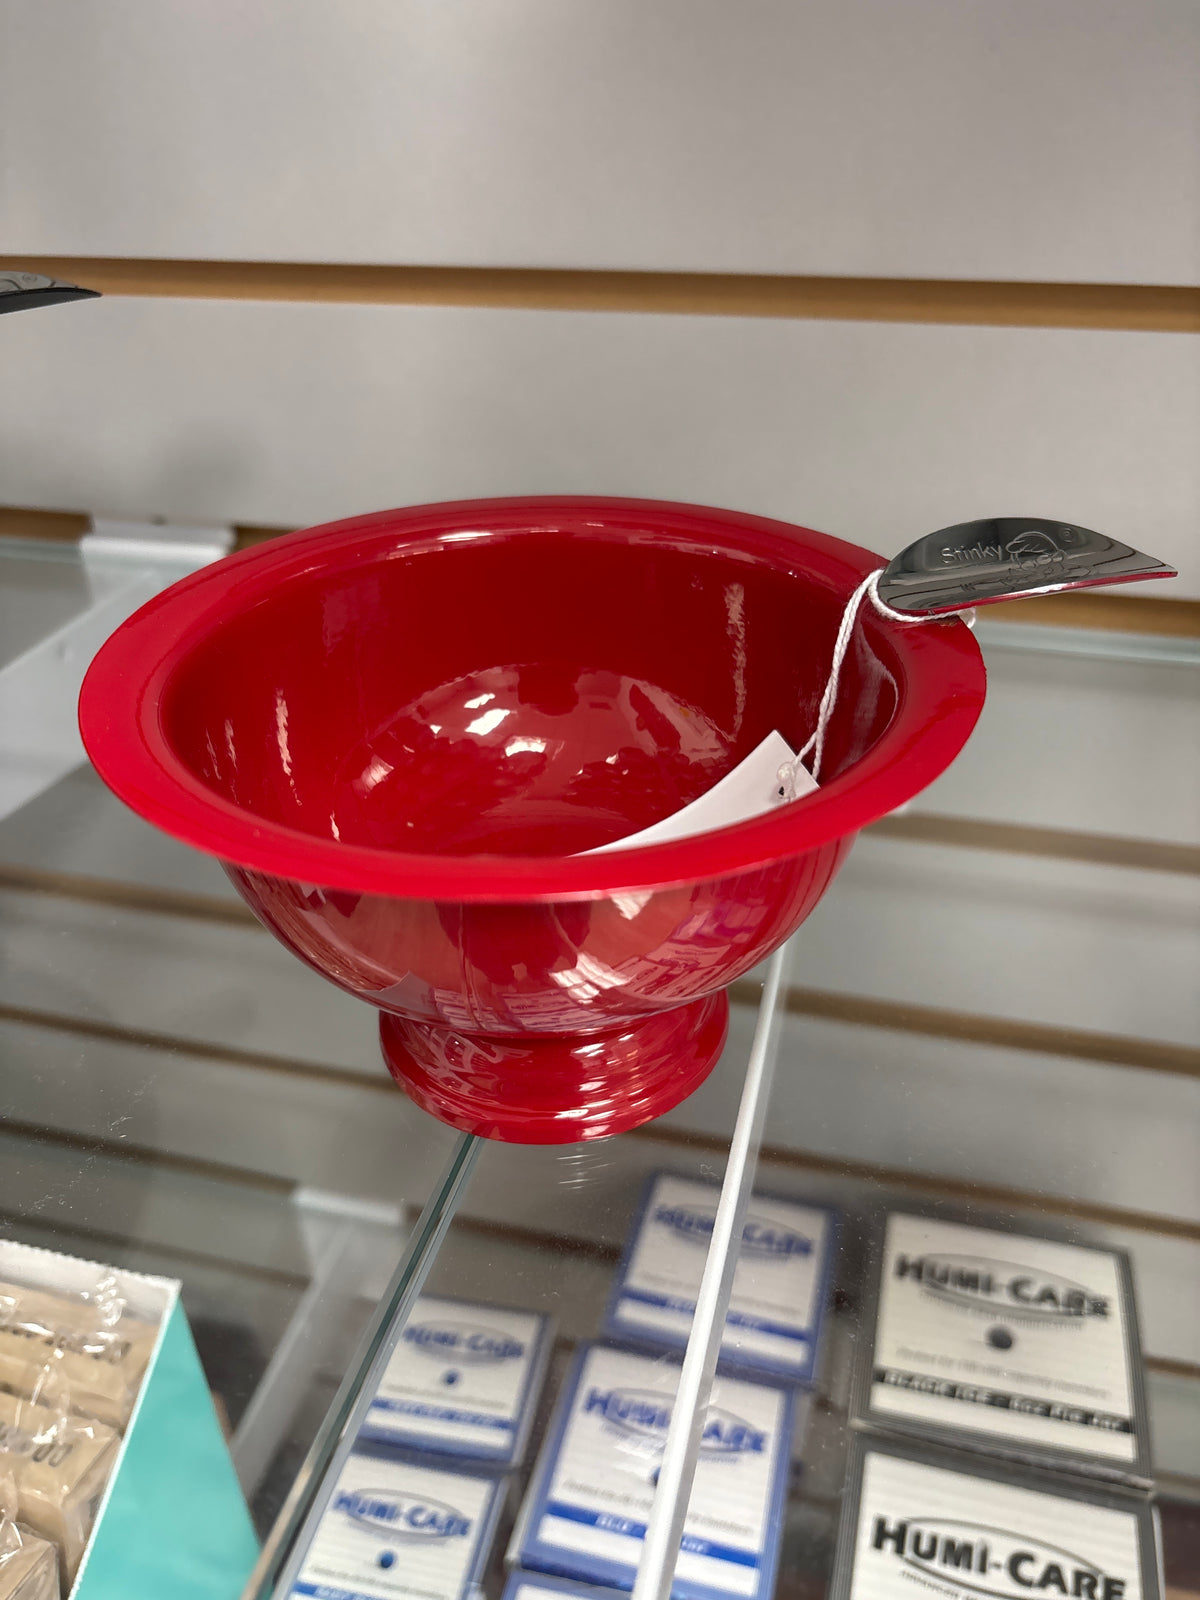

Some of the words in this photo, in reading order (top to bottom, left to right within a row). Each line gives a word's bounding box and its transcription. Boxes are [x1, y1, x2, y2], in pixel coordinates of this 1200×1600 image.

[941, 541, 1003, 564] Stinky
[894, 1252, 1109, 1319] HUMI-CARE
[873, 1513, 1126, 1600] HUMI-CARE
